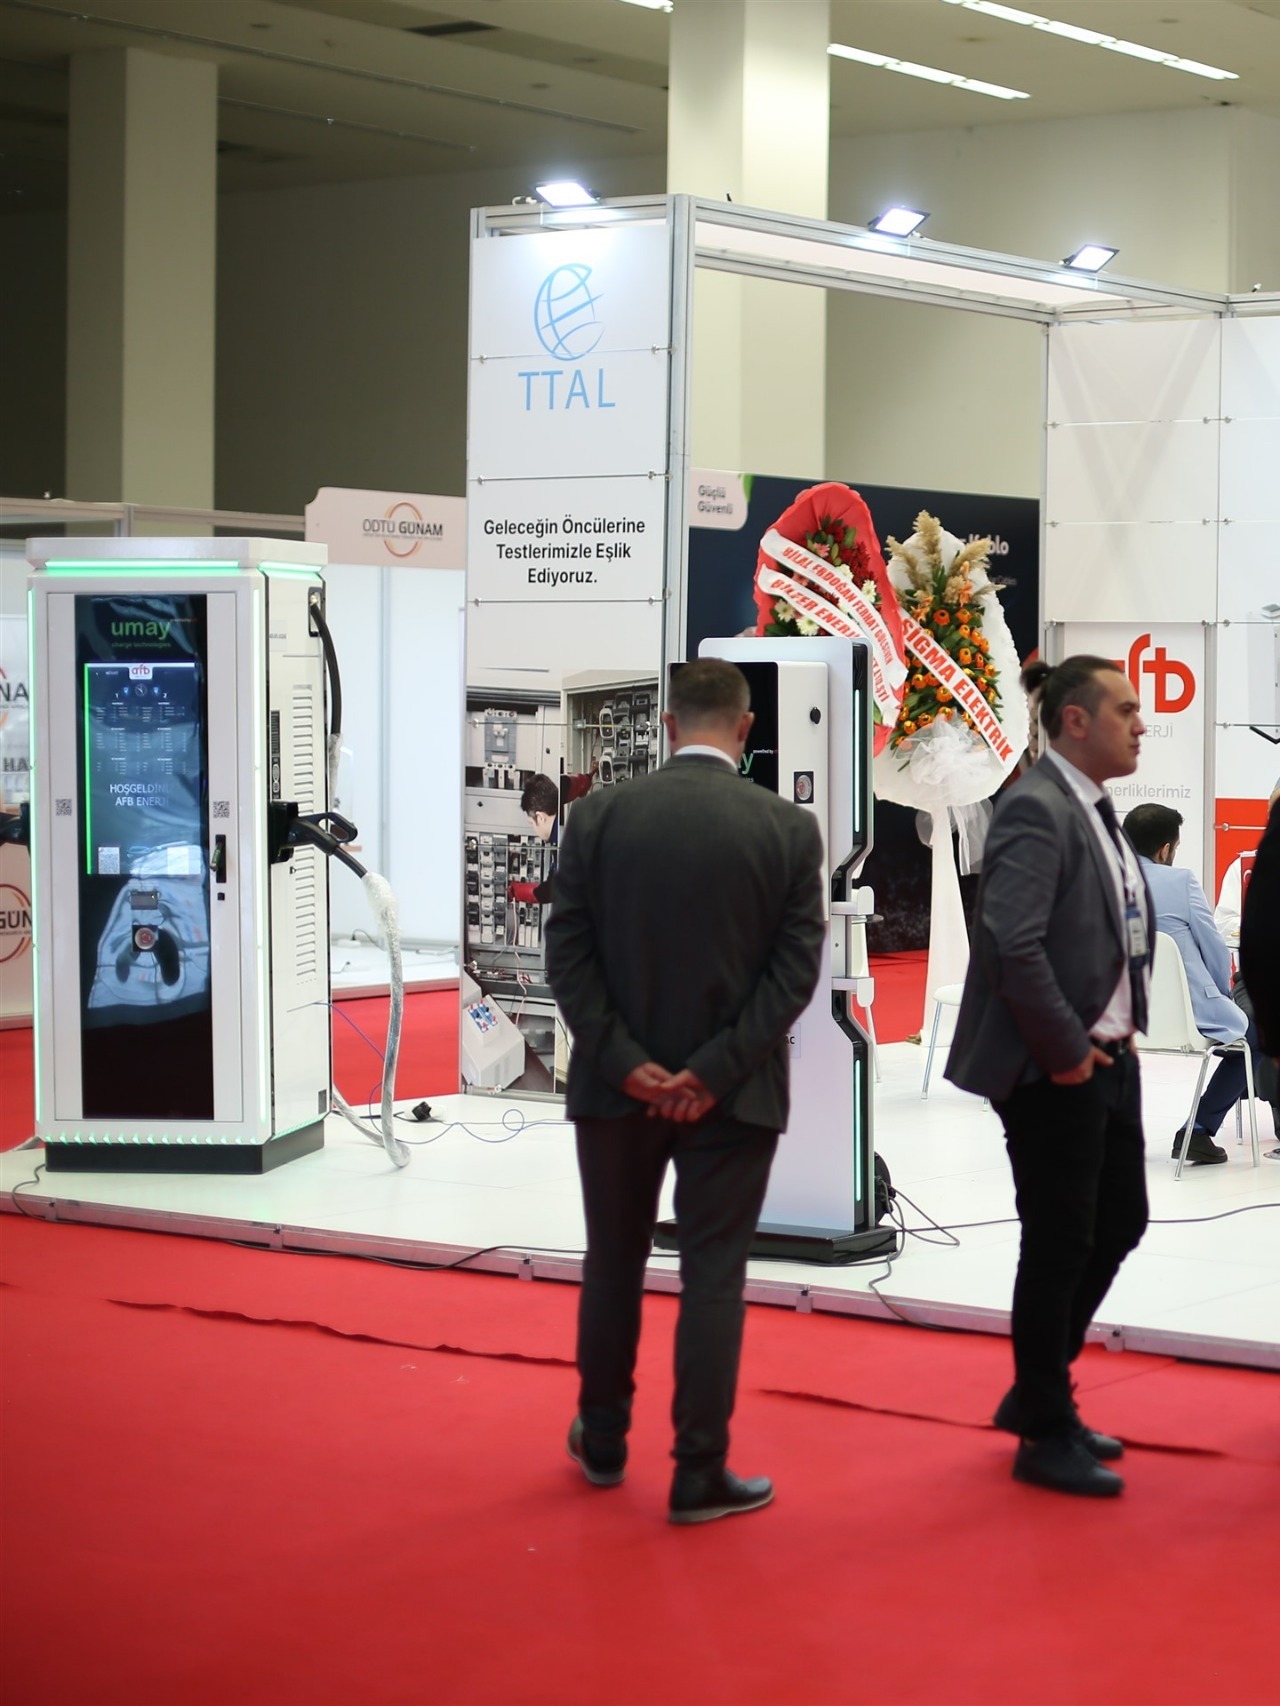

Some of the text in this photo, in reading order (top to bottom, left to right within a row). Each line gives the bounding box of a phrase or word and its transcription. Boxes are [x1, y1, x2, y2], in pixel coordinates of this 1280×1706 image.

[517, 368, 616, 411] TTAL
[484, 514, 645, 538] Geleceğin Öncülerine
[496, 542, 631, 563] Testlerimizle Eşlik
[528, 567, 598, 587] Ediyoruz.
[111, 621, 170, 640] umay
[901, 617, 1014, 763] SİGMA ELEKTRİK
